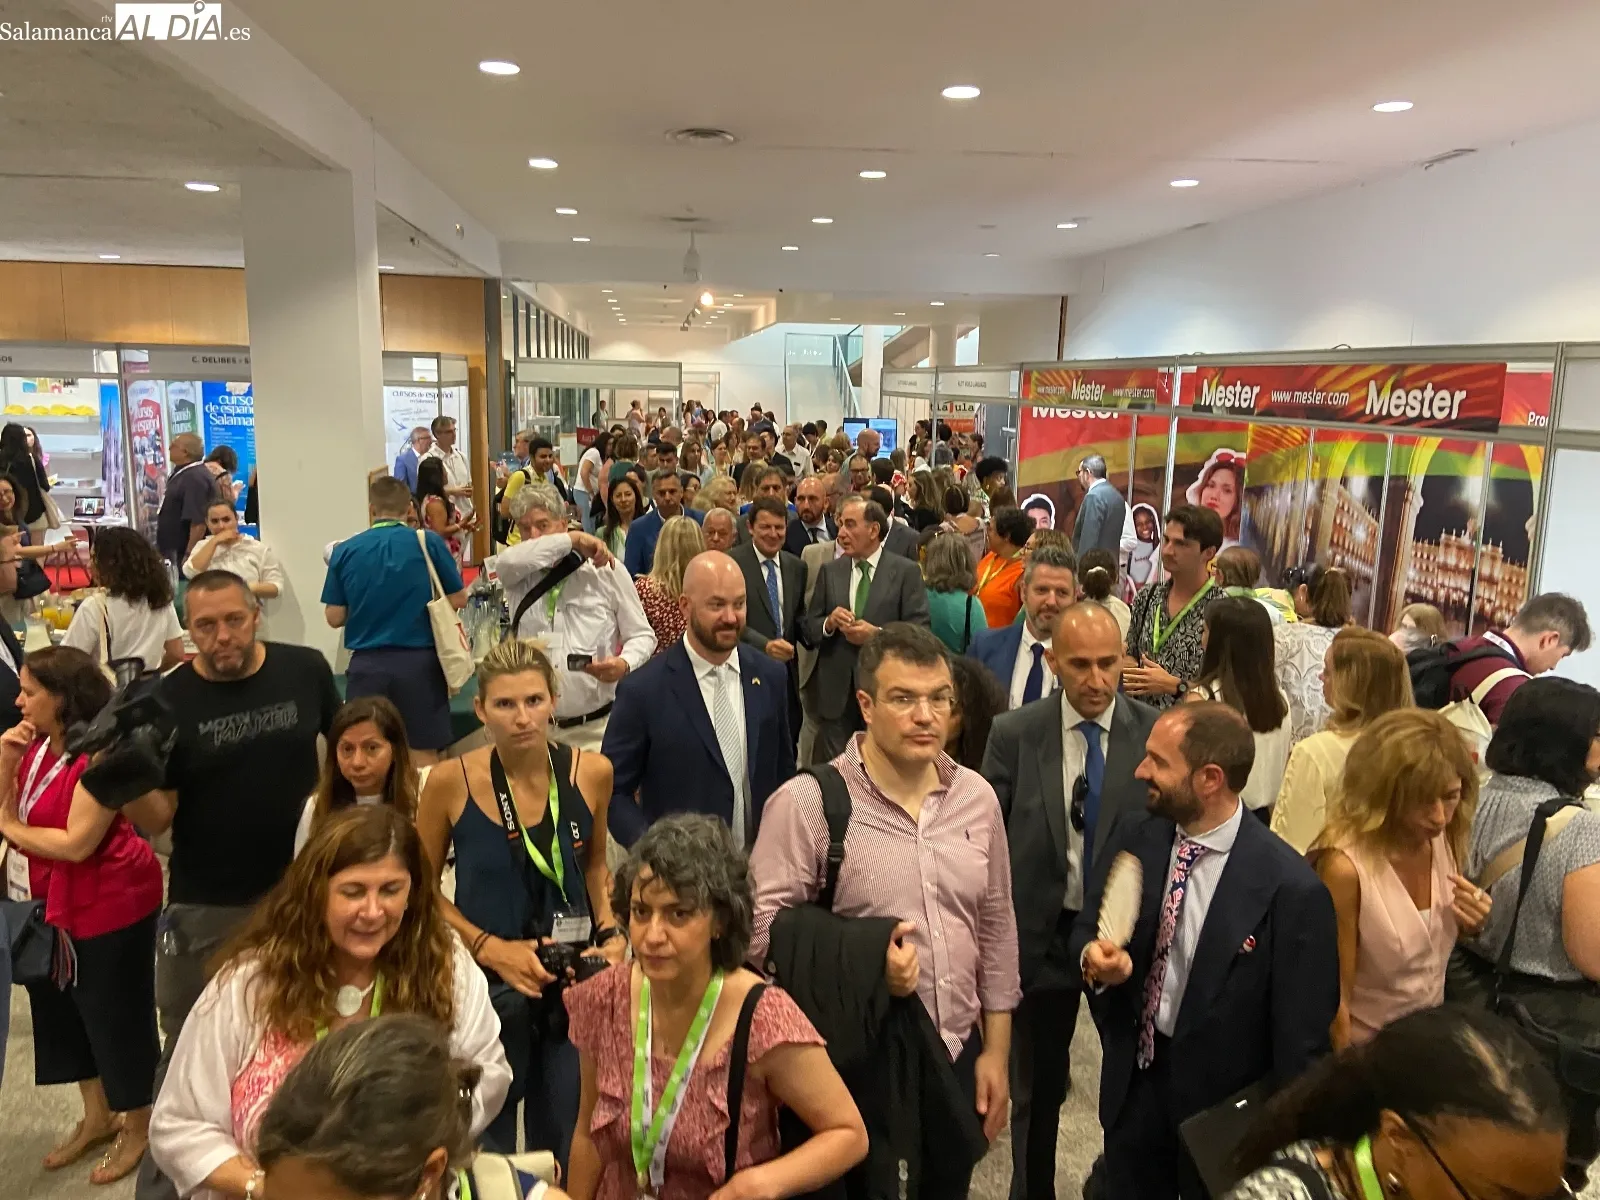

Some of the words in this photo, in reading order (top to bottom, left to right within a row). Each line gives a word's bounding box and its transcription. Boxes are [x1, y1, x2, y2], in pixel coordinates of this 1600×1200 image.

[1071, 377, 1106, 402] Mester
[1112, 386, 1155, 399] www.mester.com
[1201, 376, 1261, 409] Mester
[1271, 387, 1350, 406] www.mester.com
[1365, 377, 1467, 420] Mester
[205, 402, 219, 413] de
[499, 791, 516, 832] SONY
